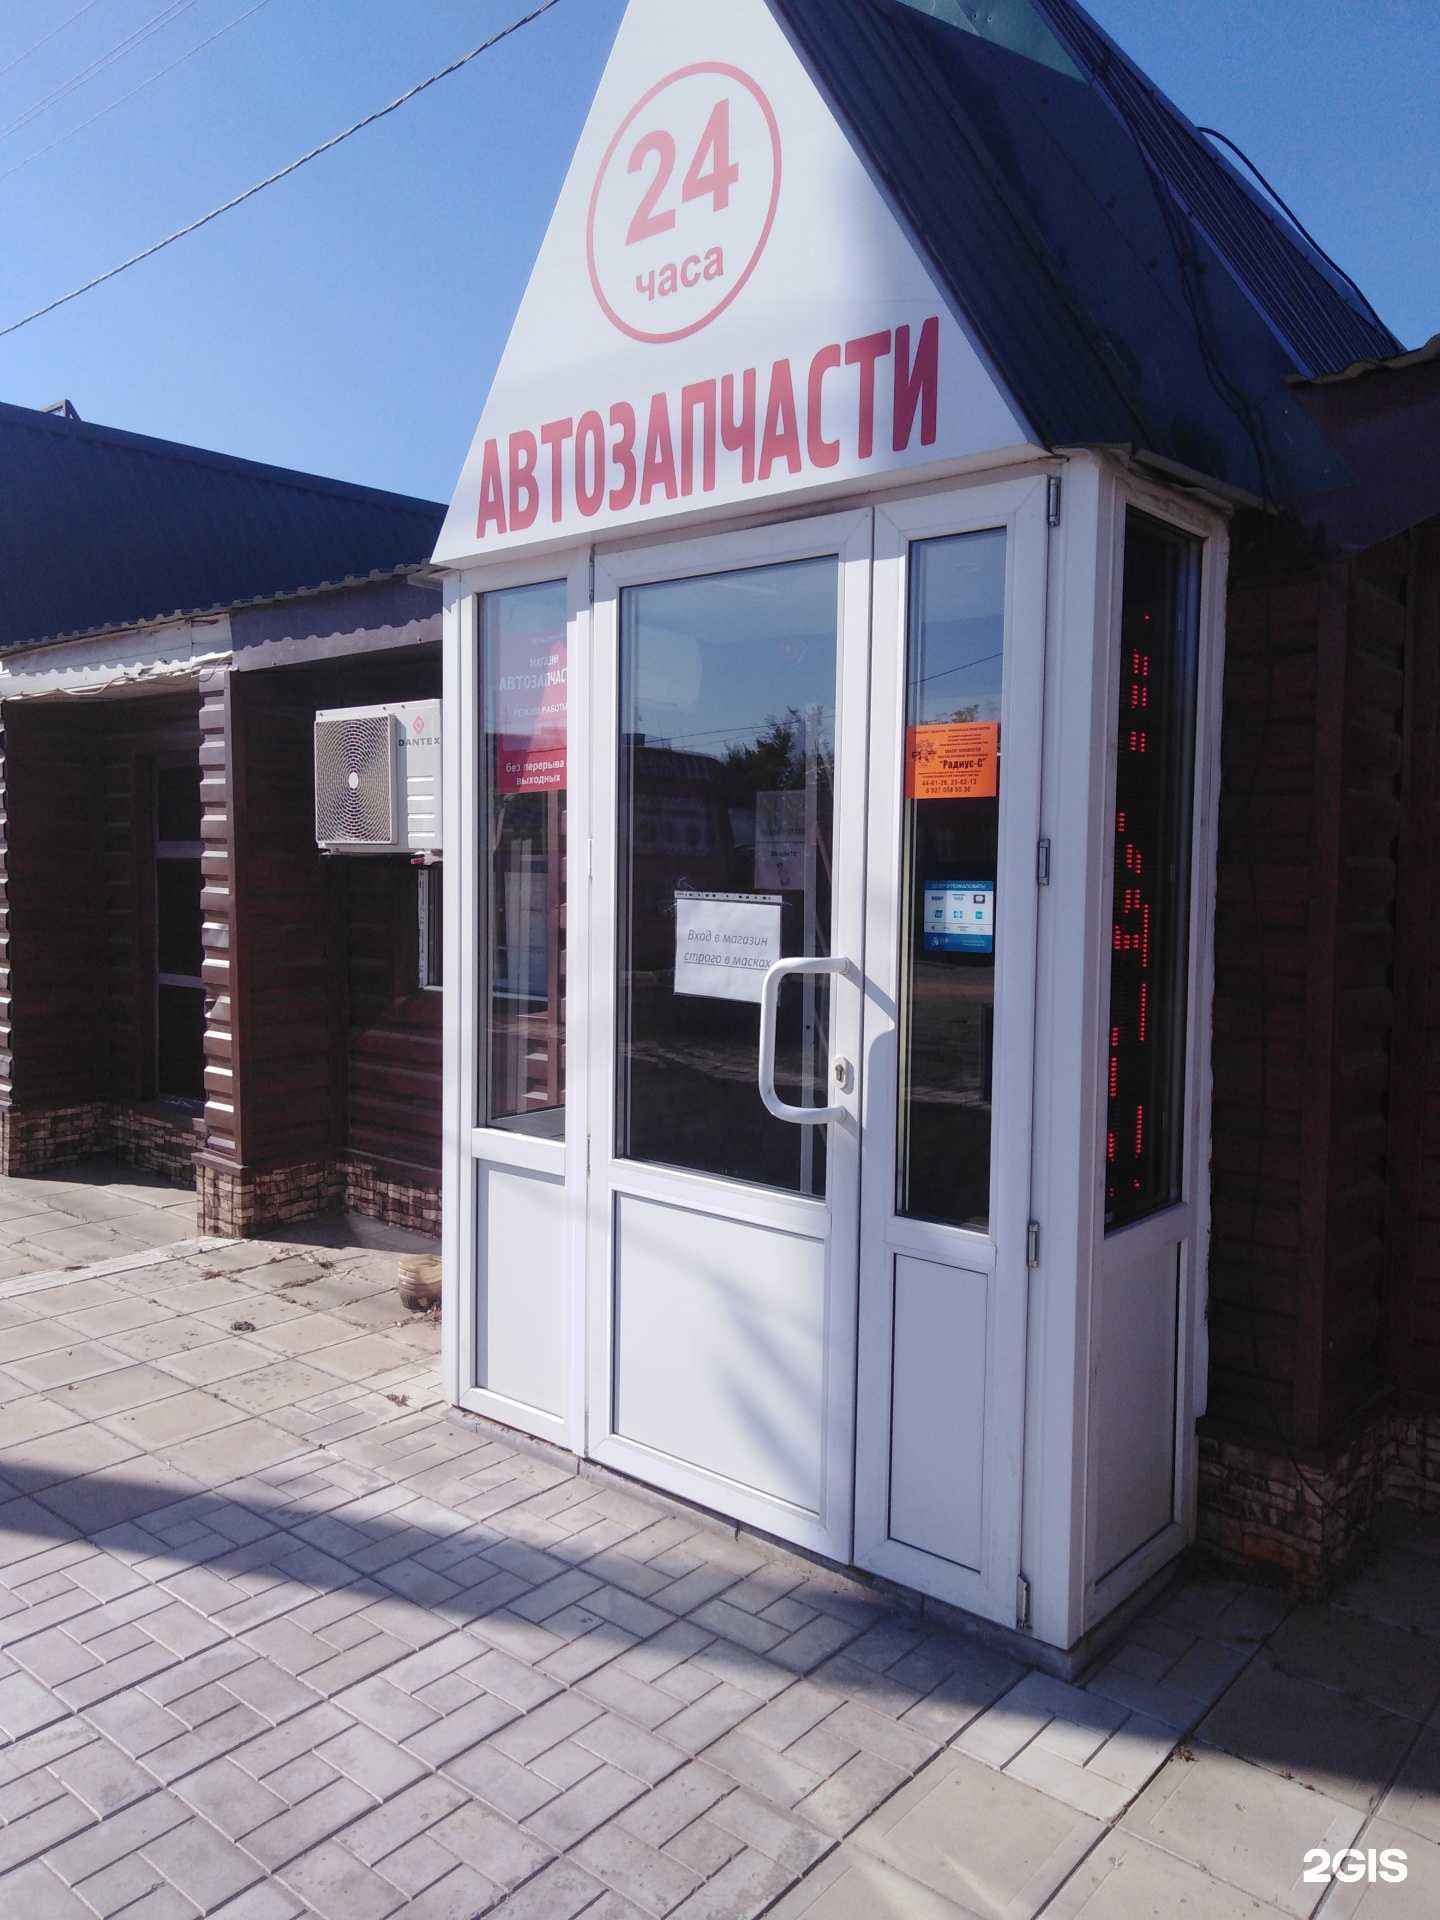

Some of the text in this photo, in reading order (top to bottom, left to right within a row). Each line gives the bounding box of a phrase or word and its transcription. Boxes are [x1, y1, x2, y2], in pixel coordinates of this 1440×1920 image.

[625, 98, 740, 246] 24
[634, 245, 725, 302] часа
[476, 316, 940, 539] АВТОЗАПЧАСТИ
[398, 737, 441, 747] DANTEX
[505, 762, 521, 773] без
[523, 760, 565, 773] перерыва
[516, 774, 561, 785] выходных
[687, 929, 769, 946] Вход в магазин
[683, 952, 772, 969] строго в масках
